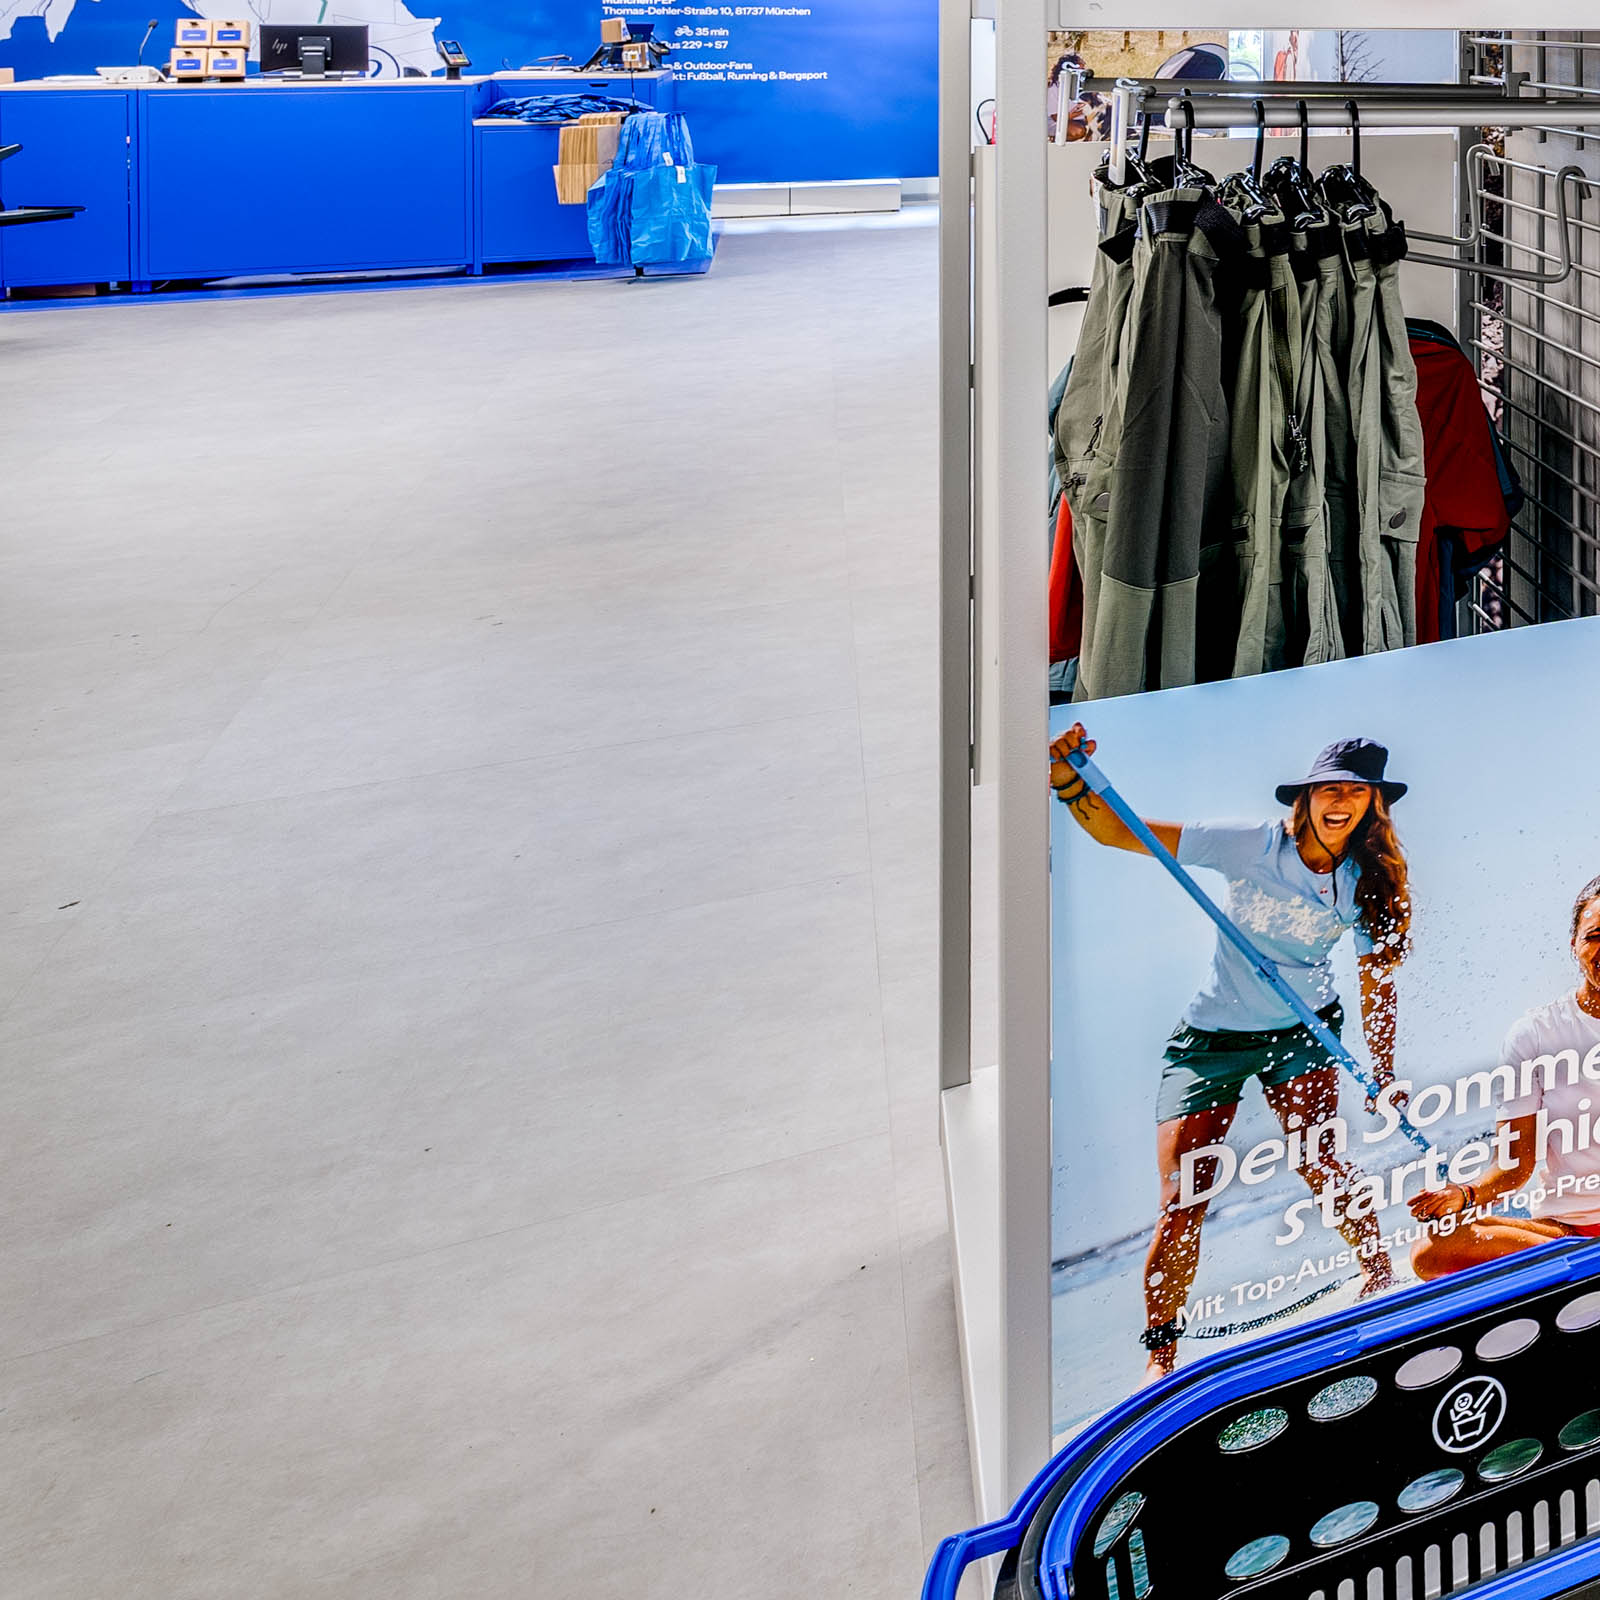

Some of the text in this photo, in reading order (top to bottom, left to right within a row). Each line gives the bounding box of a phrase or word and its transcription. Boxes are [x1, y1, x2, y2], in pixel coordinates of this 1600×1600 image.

[603, 6, 811, 17] Thomas-Dehler-Straße 10, 81737 München
[695, 28, 729, 36] 35 min
[682, 41, 702, 49] 229
[714, 41, 728, 49] S7
[674, 62, 753, 70] & Outdoor-Fans
[687, 72, 726, 81] Fußball,
[728, 72, 767, 81] Running
[769, 72, 777, 80] &
[779, 72, 828, 81] Bergsport
[1179, 1110, 1349, 1212] Dein
[1274, 1122, 1521, 1247] startet
[1176, 1296, 1225, 1330] Mit
[1230, 1215, 1458, 1312] Top-Ausrüstung
[1461, 1199, 1494, 1227] zu
